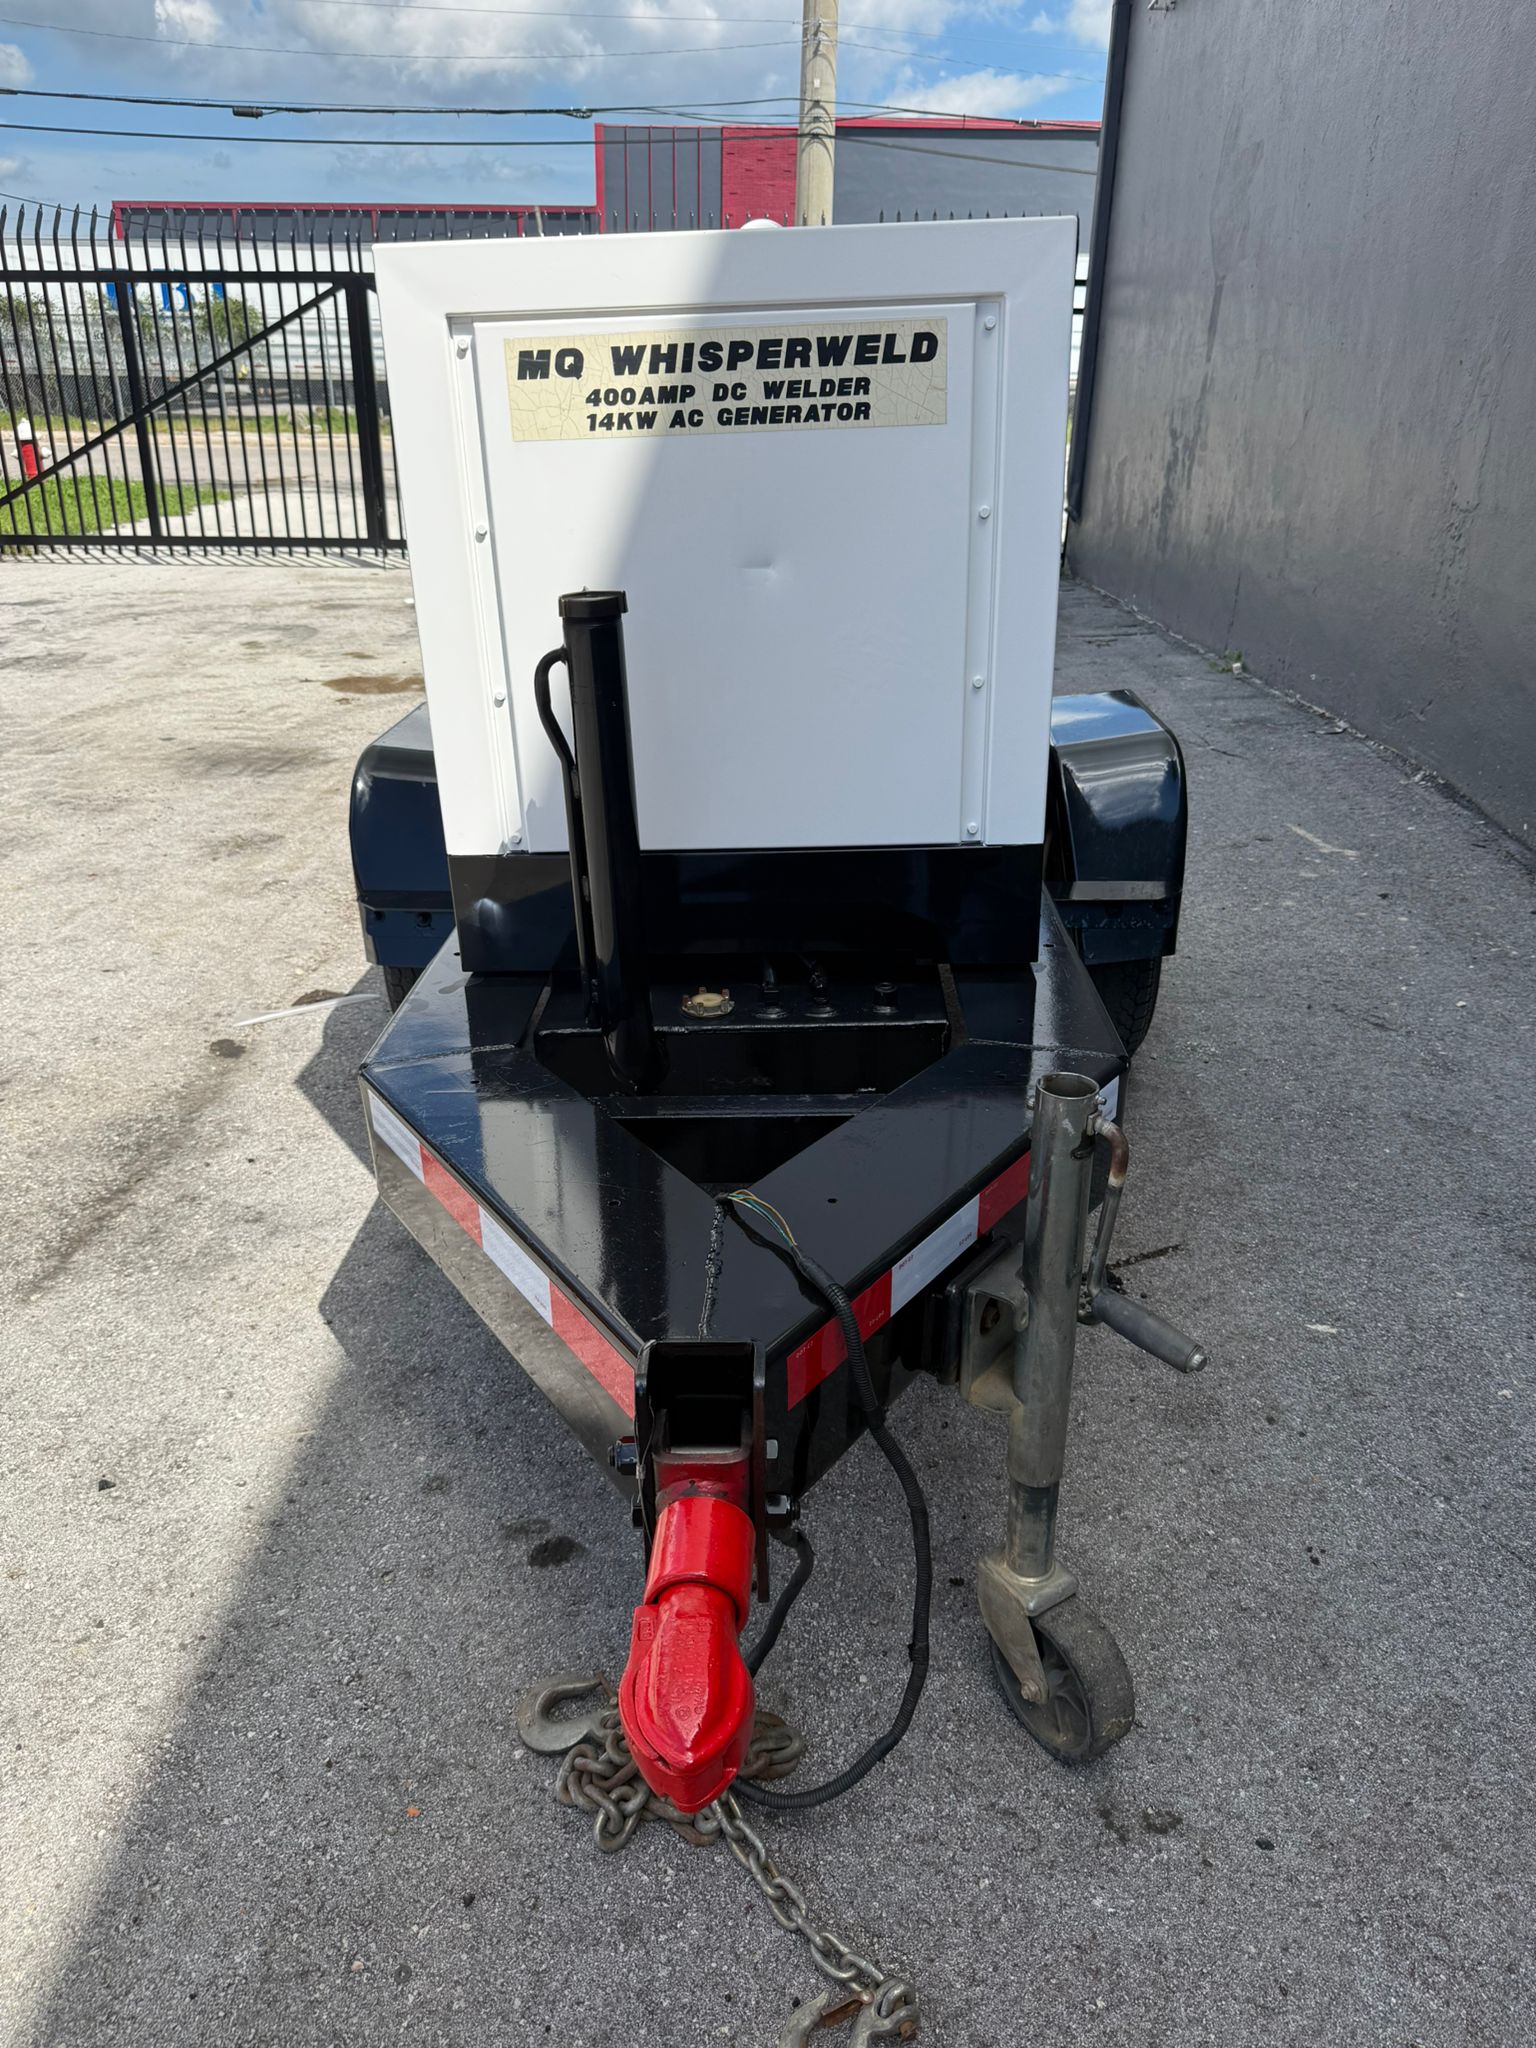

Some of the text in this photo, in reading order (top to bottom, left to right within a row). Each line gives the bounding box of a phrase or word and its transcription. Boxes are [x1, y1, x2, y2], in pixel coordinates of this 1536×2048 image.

[517, 331, 939, 380] MQ WHISPERWELD
[585, 376, 872, 407] 400AMP DC WELDER
[586, 401, 872, 431] 14KW AC GENERATOR
